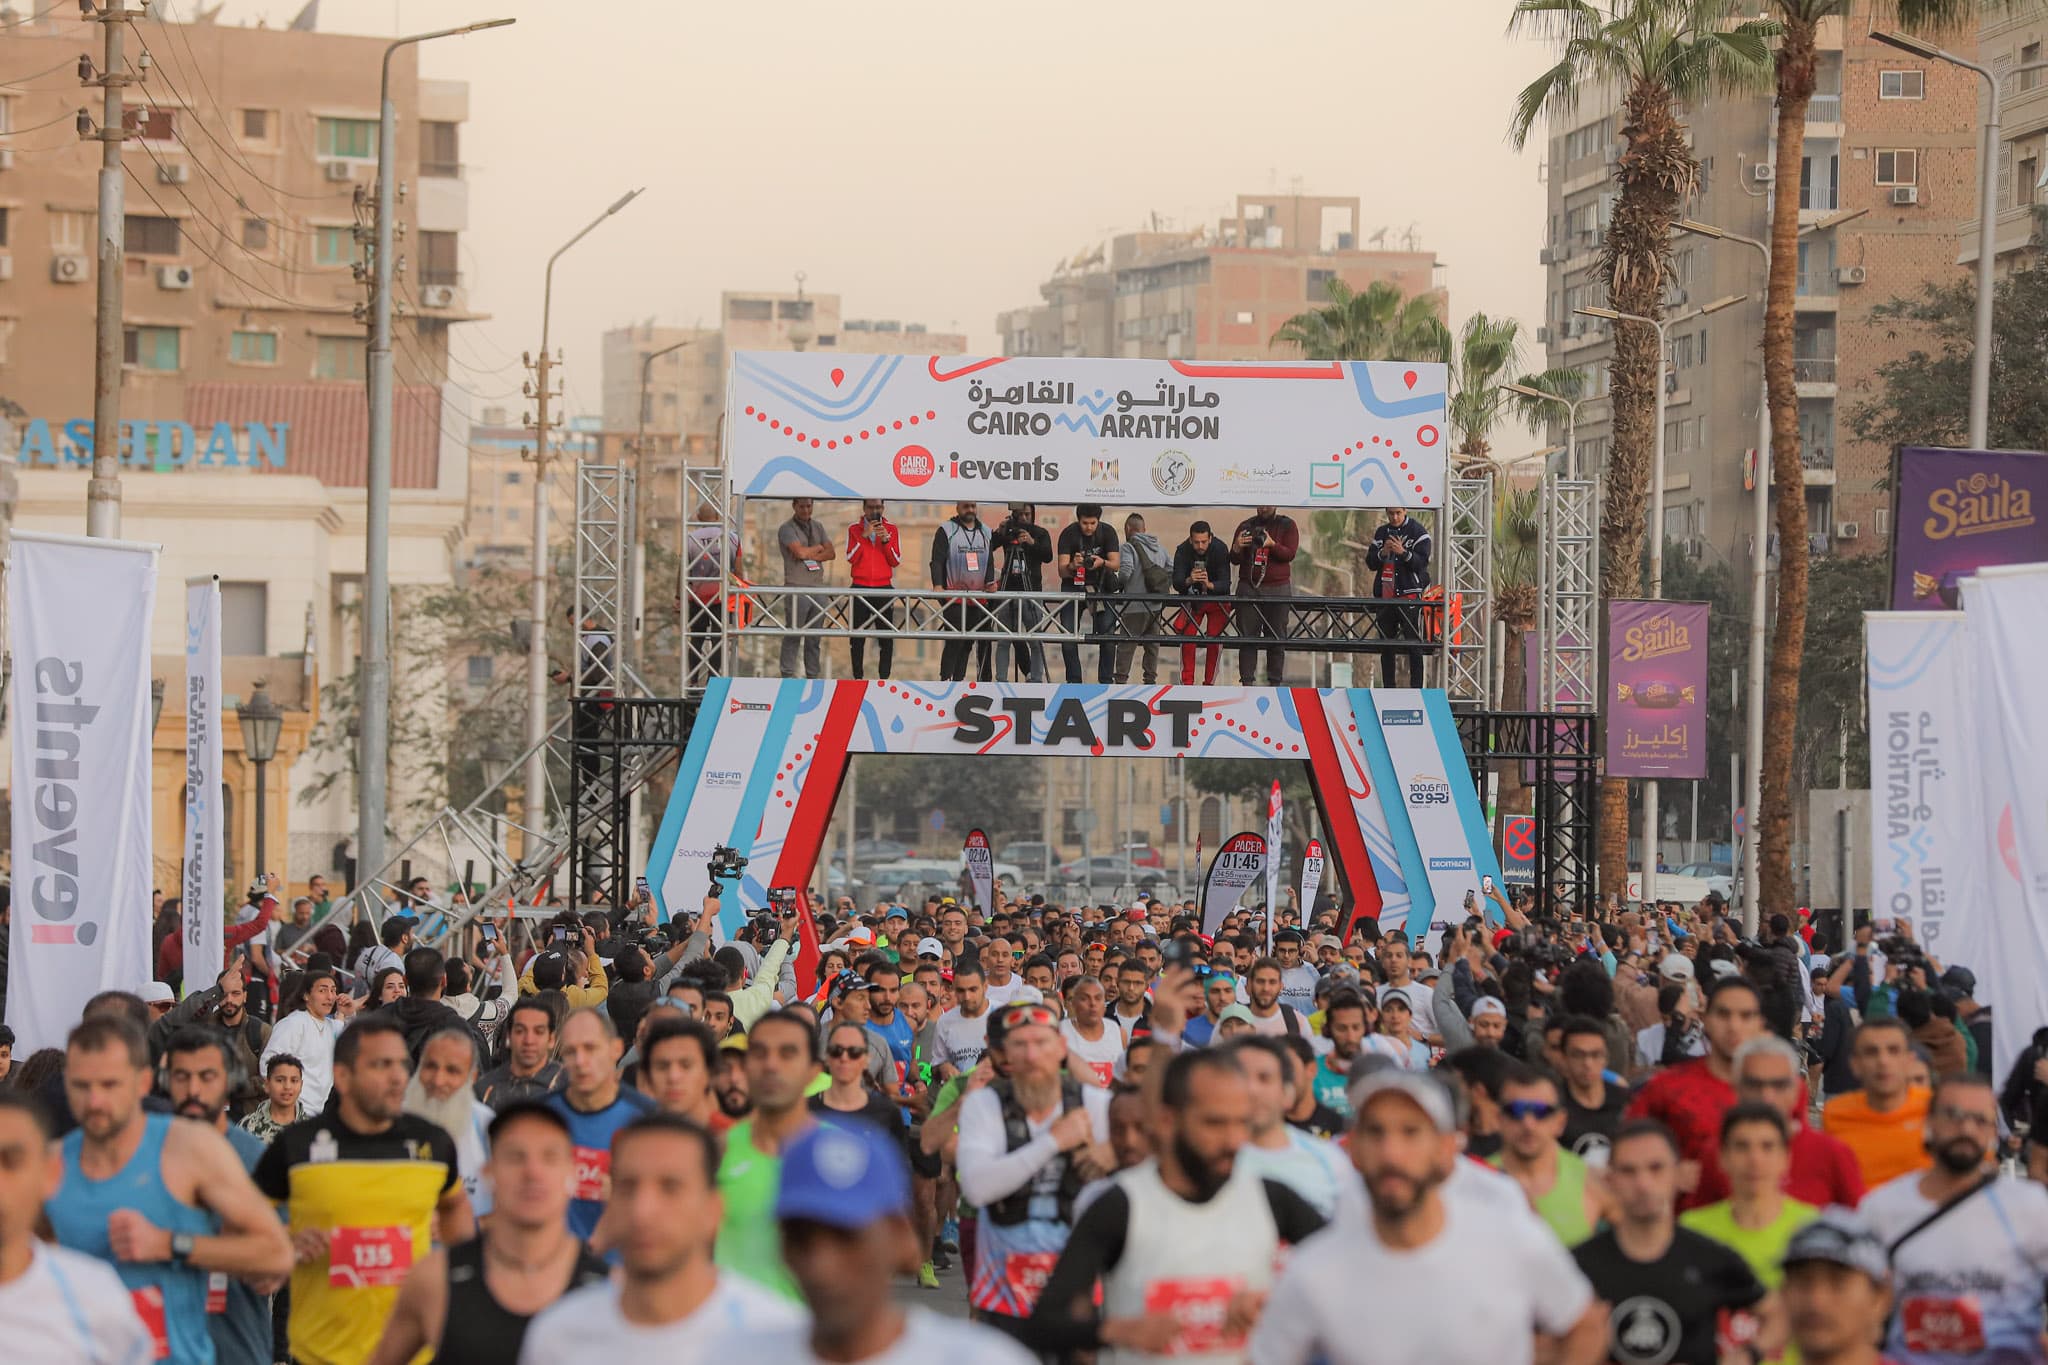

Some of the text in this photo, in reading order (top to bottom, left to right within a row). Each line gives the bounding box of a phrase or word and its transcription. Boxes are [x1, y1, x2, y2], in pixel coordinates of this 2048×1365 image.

[967, 379, 1074, 409] القاهرة
[967, 411, 1051, 435] CAIRO
[900, 456, 928, 468] CAIRO
[950, 451, 1059, 481] ievents
[1923, 480, 2032, 540] Saula
[1623, 620, 1689, 662] Saula
[953, 694, 1203, 748] START
[1623, 723, 1689, 751] إكليرز
[1410, 784, 1449, 792] 100.6 FM
[1234, 840, 1262, 853] PACER
[1222, 853, 1260, 870] 01:45
